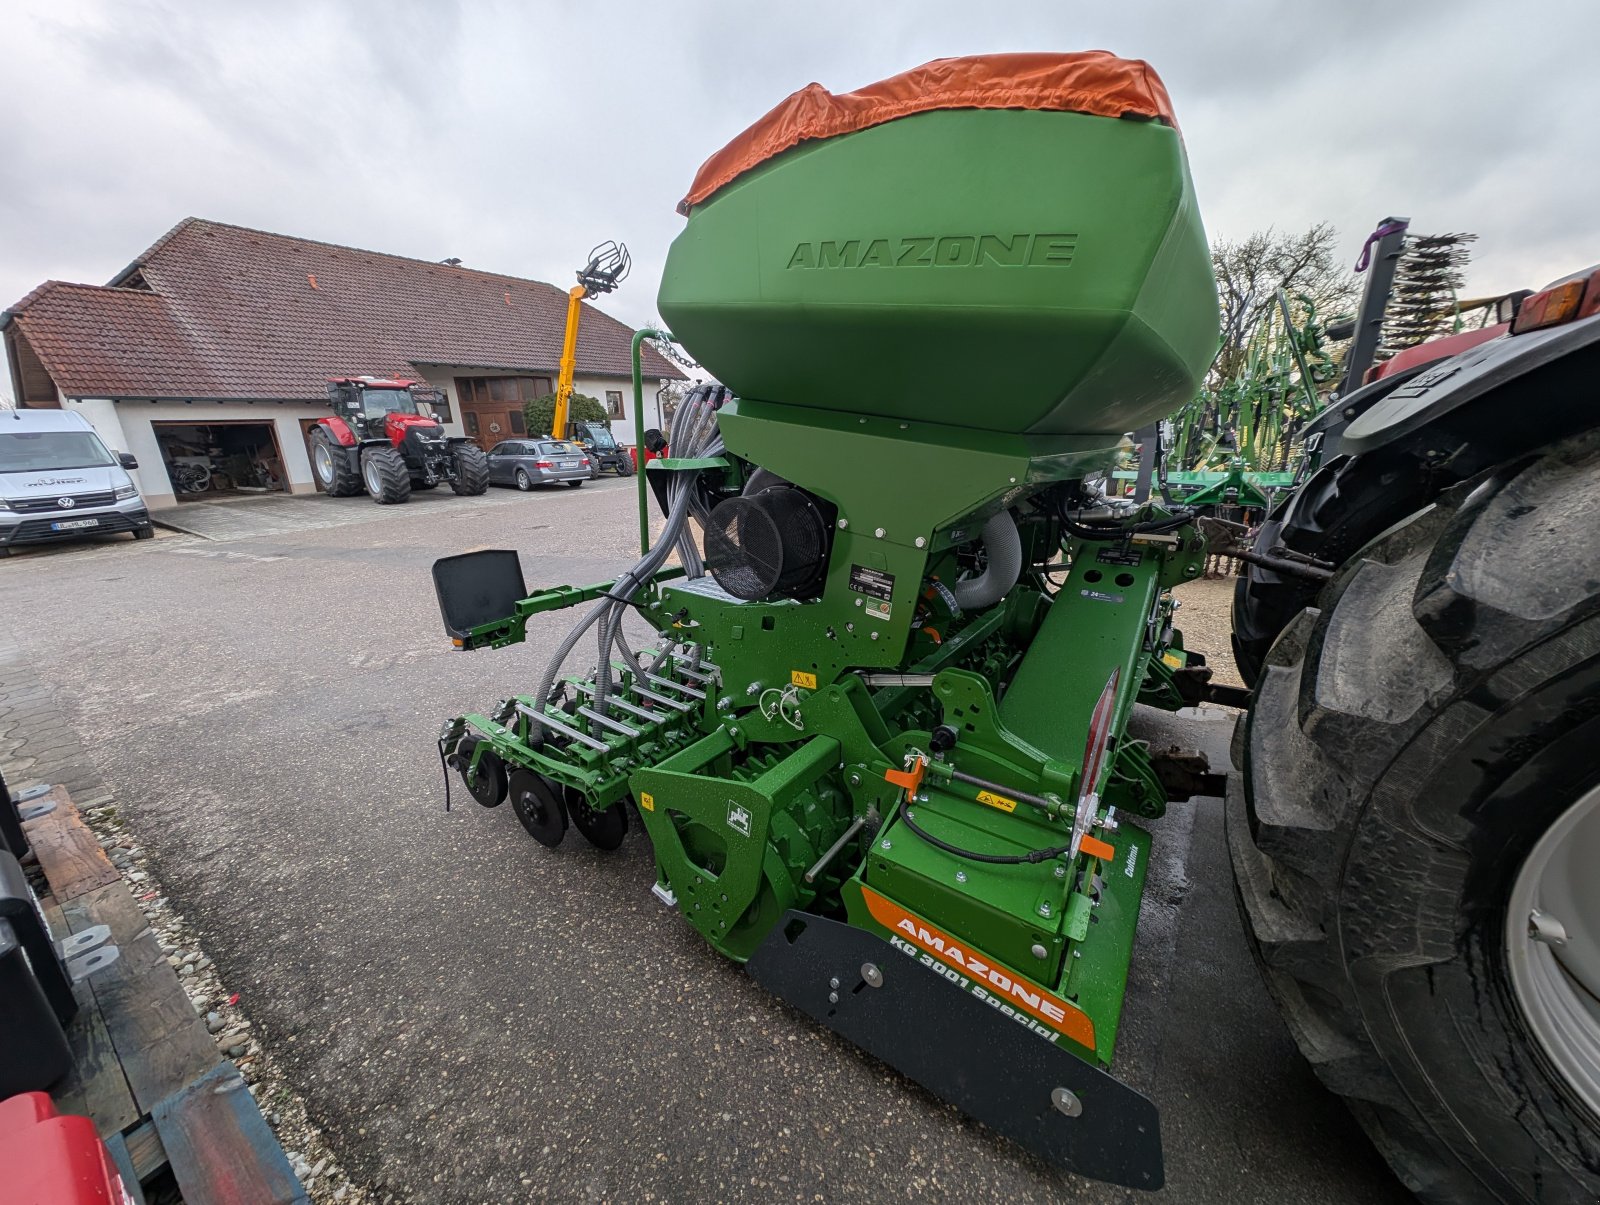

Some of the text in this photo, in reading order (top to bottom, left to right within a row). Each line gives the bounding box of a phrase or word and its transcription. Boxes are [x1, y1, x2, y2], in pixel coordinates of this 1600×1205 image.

[786, 233, 1080, 270] AMAZONE
[1125, 844, 1138, 877] Cultimix
[890, 935, 1060, 1043] KG 3001 Special
[897, 918, 1066, 1024] AMAZONE
